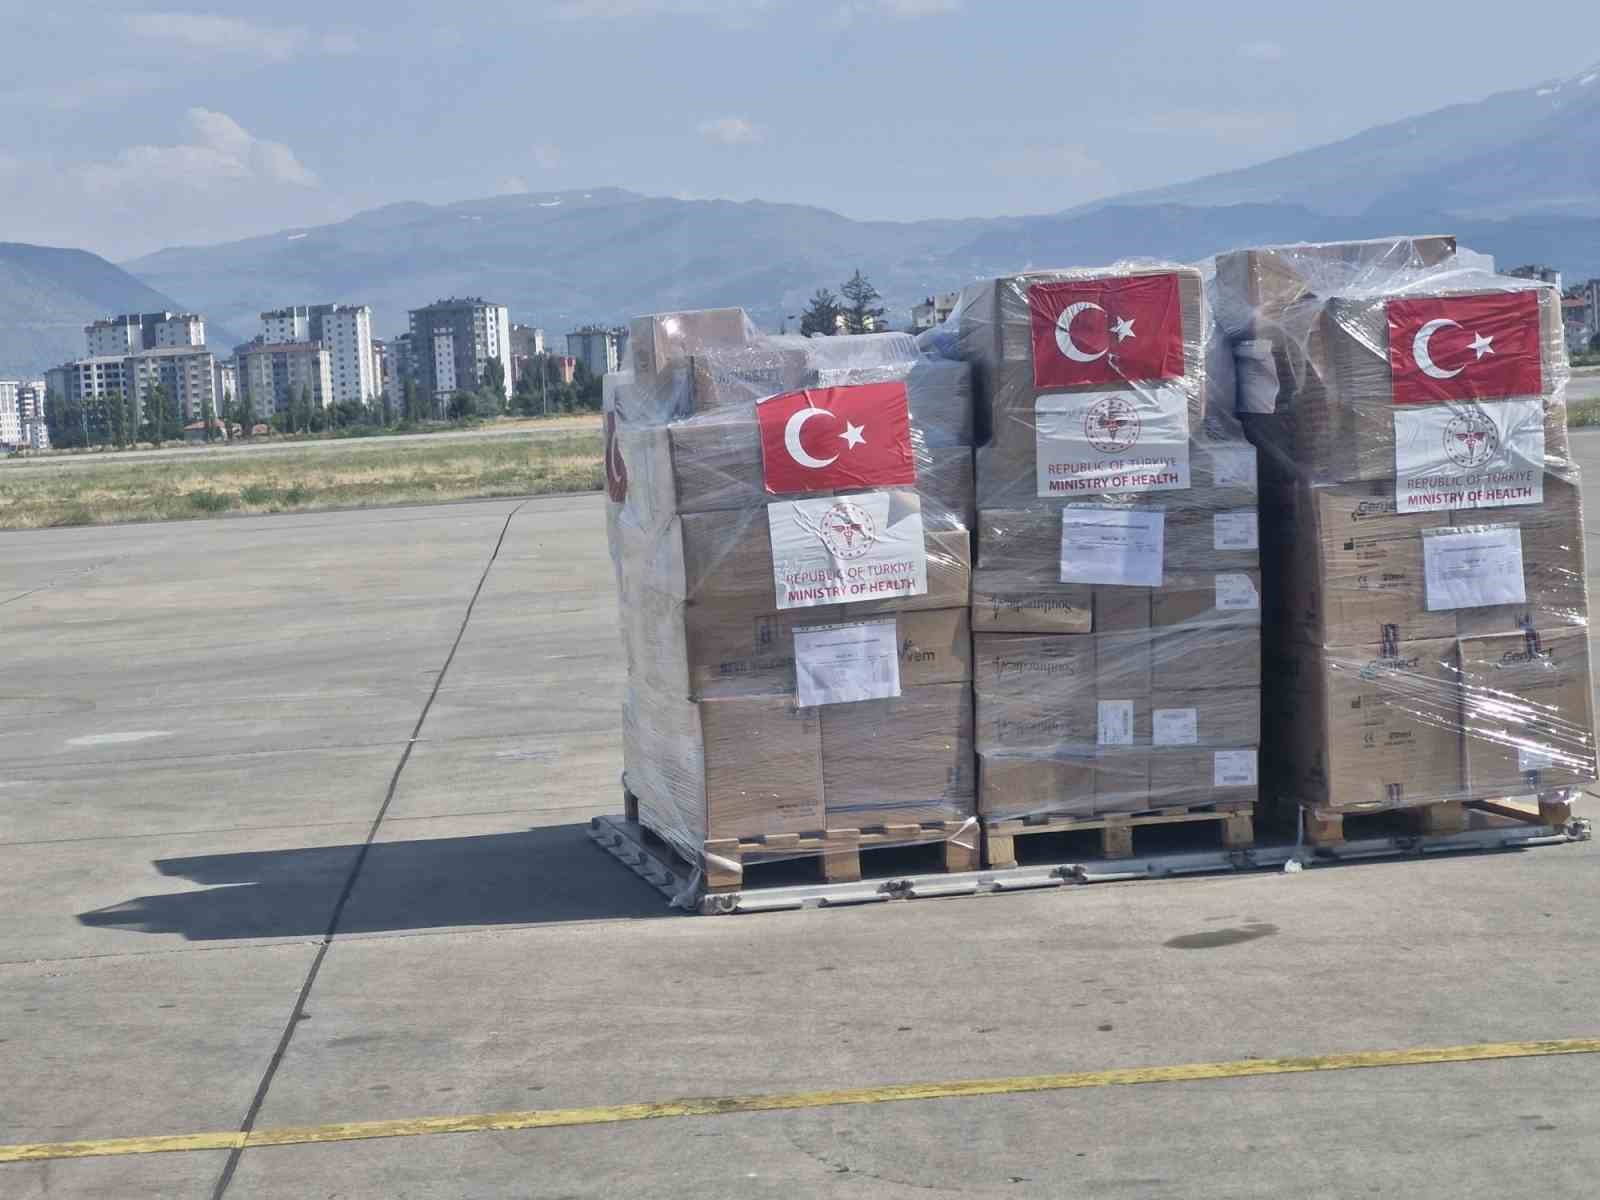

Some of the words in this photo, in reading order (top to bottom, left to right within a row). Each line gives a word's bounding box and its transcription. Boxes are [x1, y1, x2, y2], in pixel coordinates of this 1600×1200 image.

[1048, 461, 1105, 474] REPUBLIC
[1110, 460, 1124, 471] OF
[1049, 479, 1110, 491] MINISTRY
[1112, 476, 1128, 487] OF
[1132, 473, 1179, 485] HEALTH
[1408, 475, 1462, 489] REPUBLIC
[1466, 474, 1481, 485] OF
[1408, 492, 1464, 505] MINISTRY
[1467, 490, 1484, 501] OF
[1486, 487, 1532, 500] HEALTH
[787, 569, 844, 584] REPUBLIC
[847, 567, 864, 578] OF
[788, 586, 847, 601] MINISTRY
[850, 583, 866, 595] OF
[869, 578, 916, 593] HEALTH
